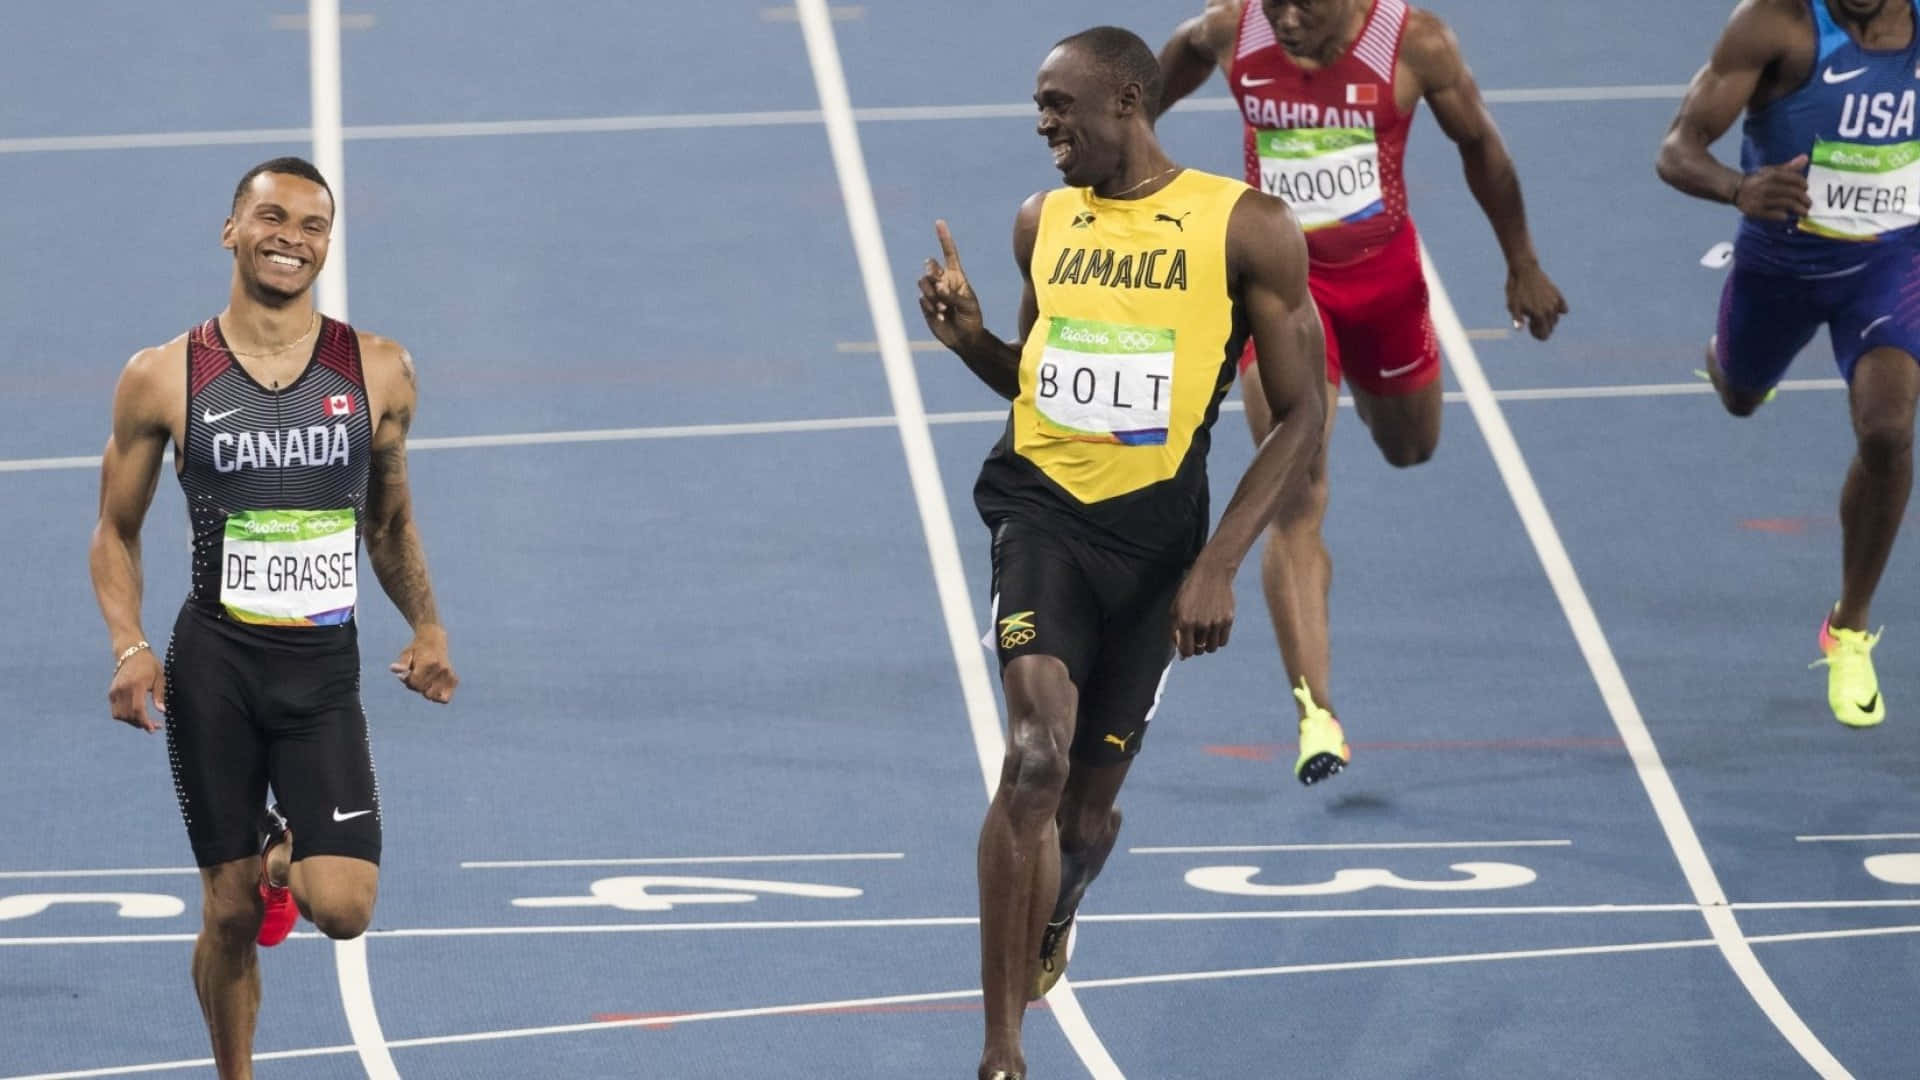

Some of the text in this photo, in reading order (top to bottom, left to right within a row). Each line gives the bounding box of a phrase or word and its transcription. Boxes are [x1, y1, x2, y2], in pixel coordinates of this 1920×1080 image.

[1243, 93, 1376, 129] BAHRAIN
[1837, 90, 1916, 139] USA
[1263, 158, 1376, 204] YAQOOB
[1826, 183, 1907, 214] WEBB
[1048, 247, 1188, 291] JAMAICA
[1060, 326, 1109, 345] Rio2016
[1039, 362, 1170, 411] BOLT
[212, 423, 350, 473] CANADA
[226, 551, 354, 592] DE GRASSE
